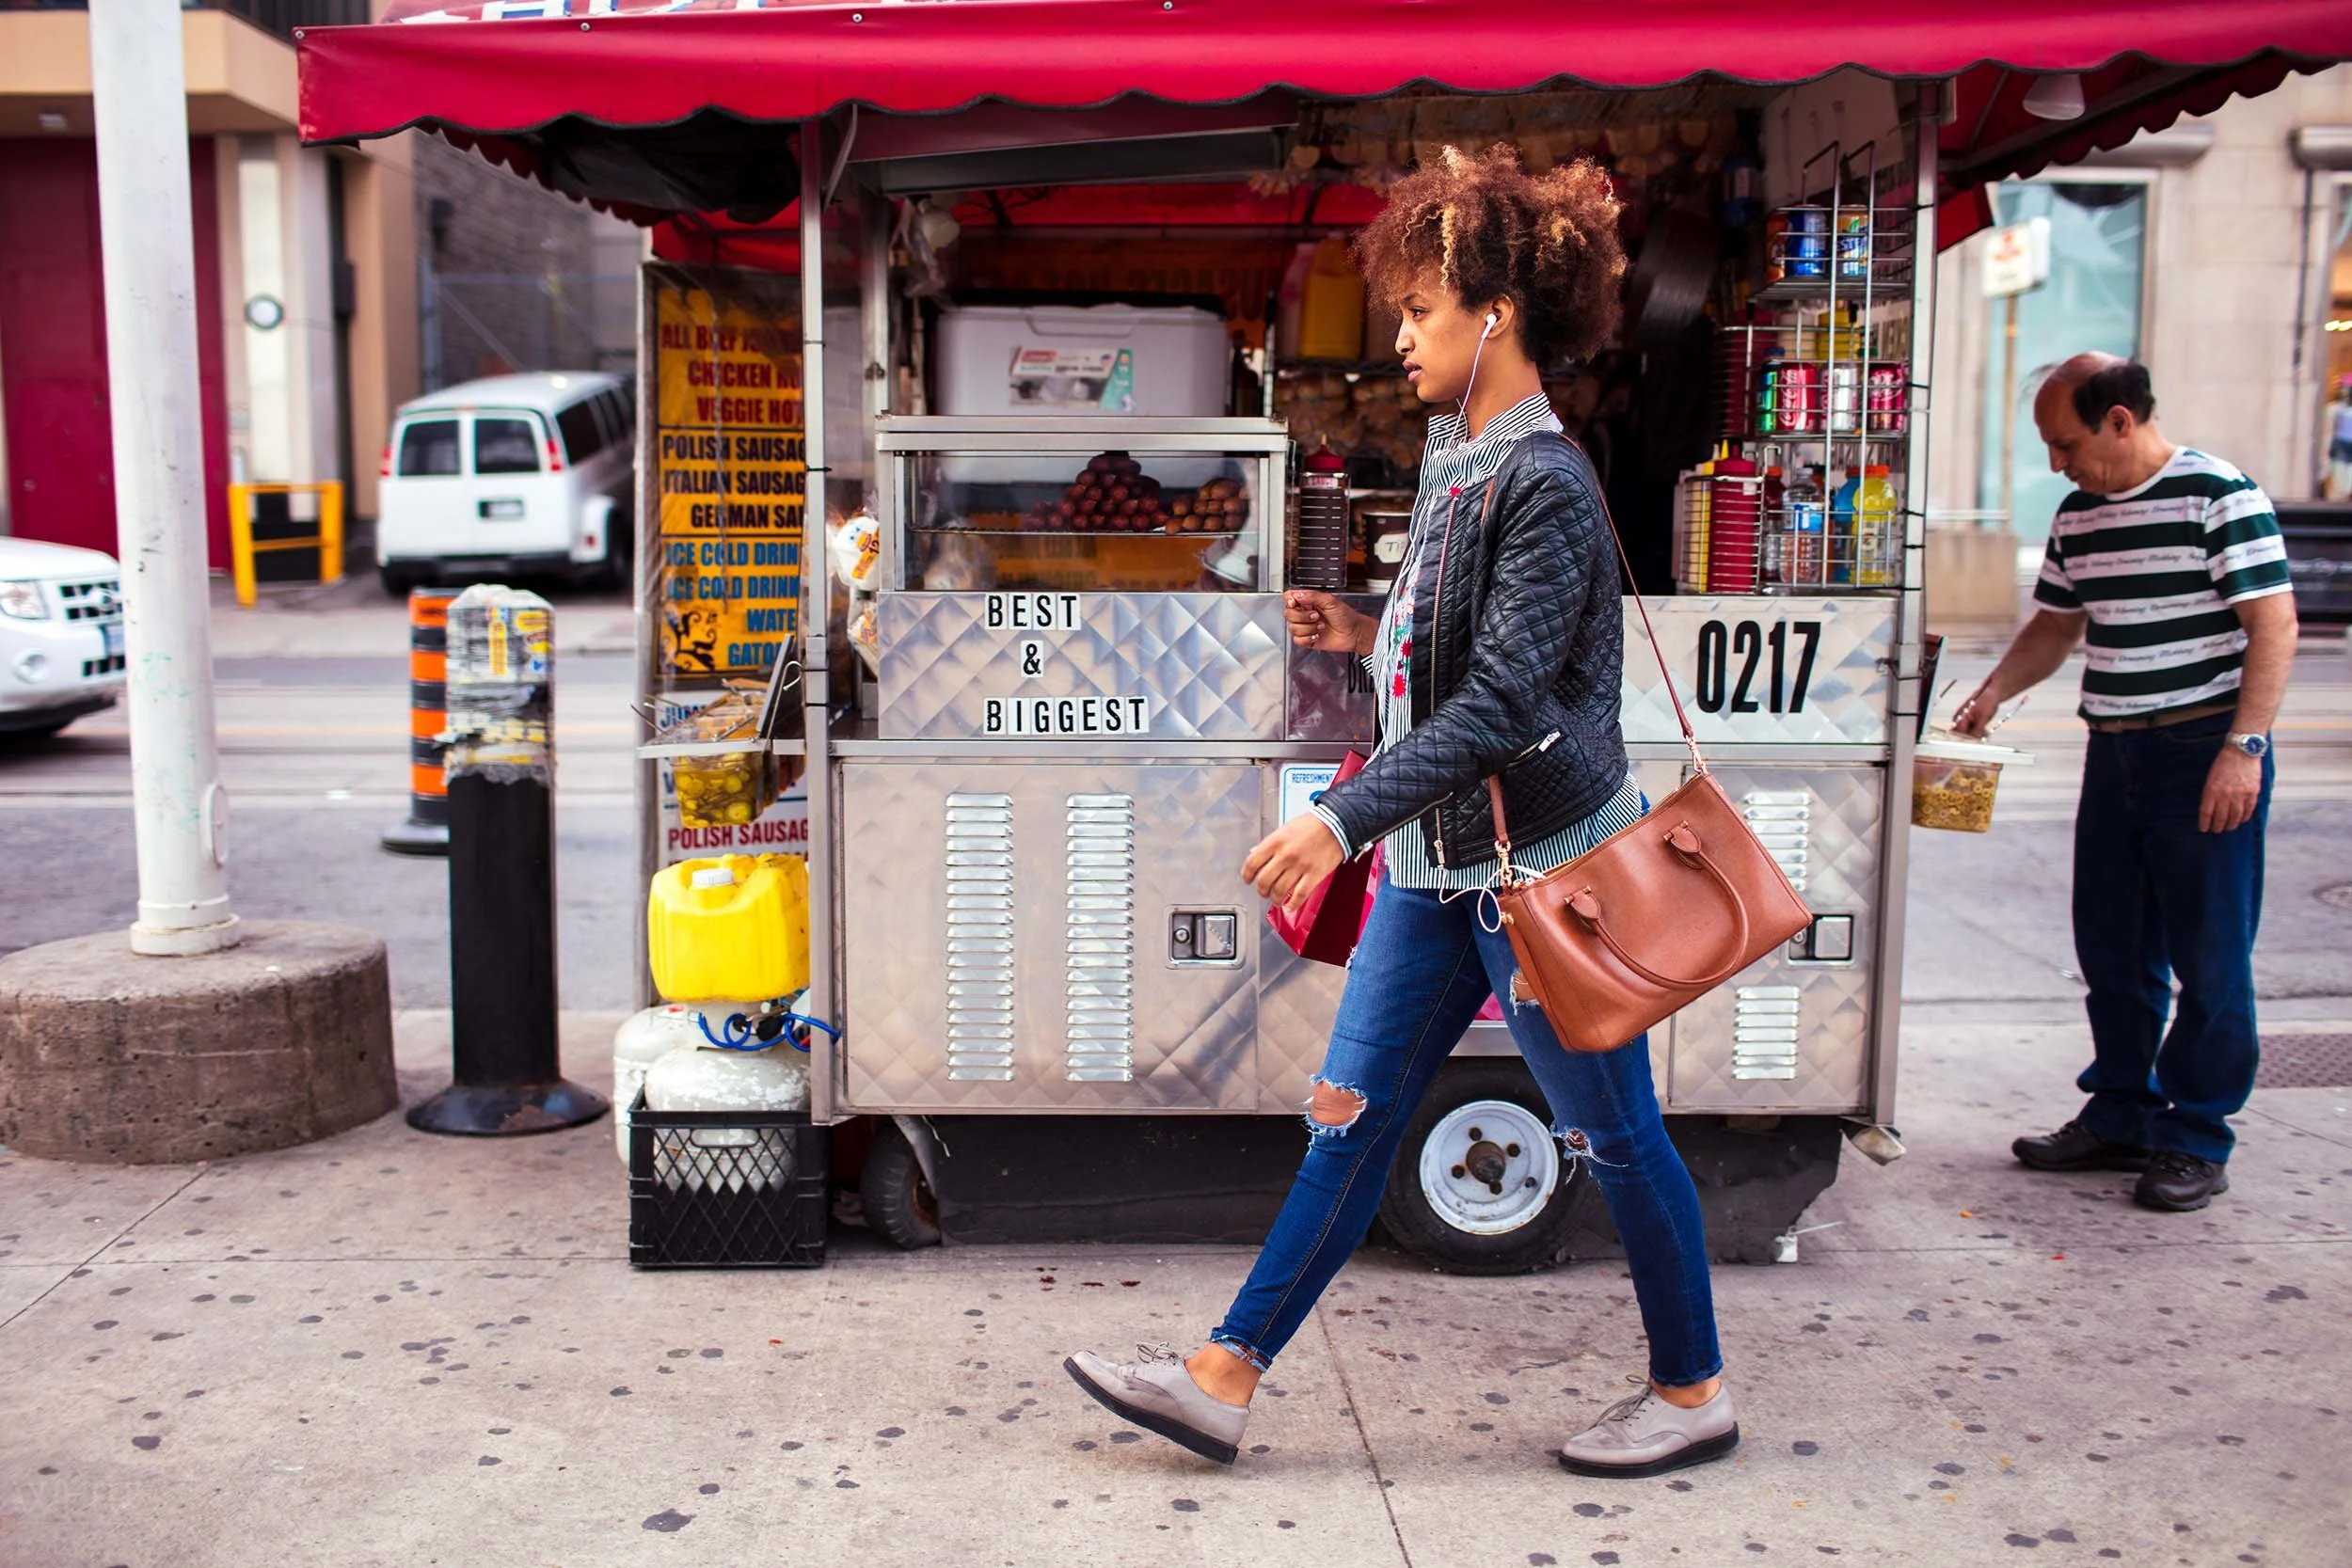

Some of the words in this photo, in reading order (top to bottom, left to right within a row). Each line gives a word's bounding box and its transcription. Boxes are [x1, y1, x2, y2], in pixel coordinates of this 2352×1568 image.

[696, 326, 737, 352] BEF
[688, 361, 771, 388] CHCKEN
[662, 435, 730, 459] POLISH
[664, 470, 731, 493] ITALIAN
[737, 472, 805, 494] SAUSAG
[665, 543, 695, 566] ICE
[701, 543, 749, 566] COLD
[988, 594, 1077, 627] BEST
[1023, 643, 1041, 675] &
[1696, 619, 1821, 714] 0217
[986, 698, 1145, 733] BIGGEST
[668, 825, 733, 851] POLISH
